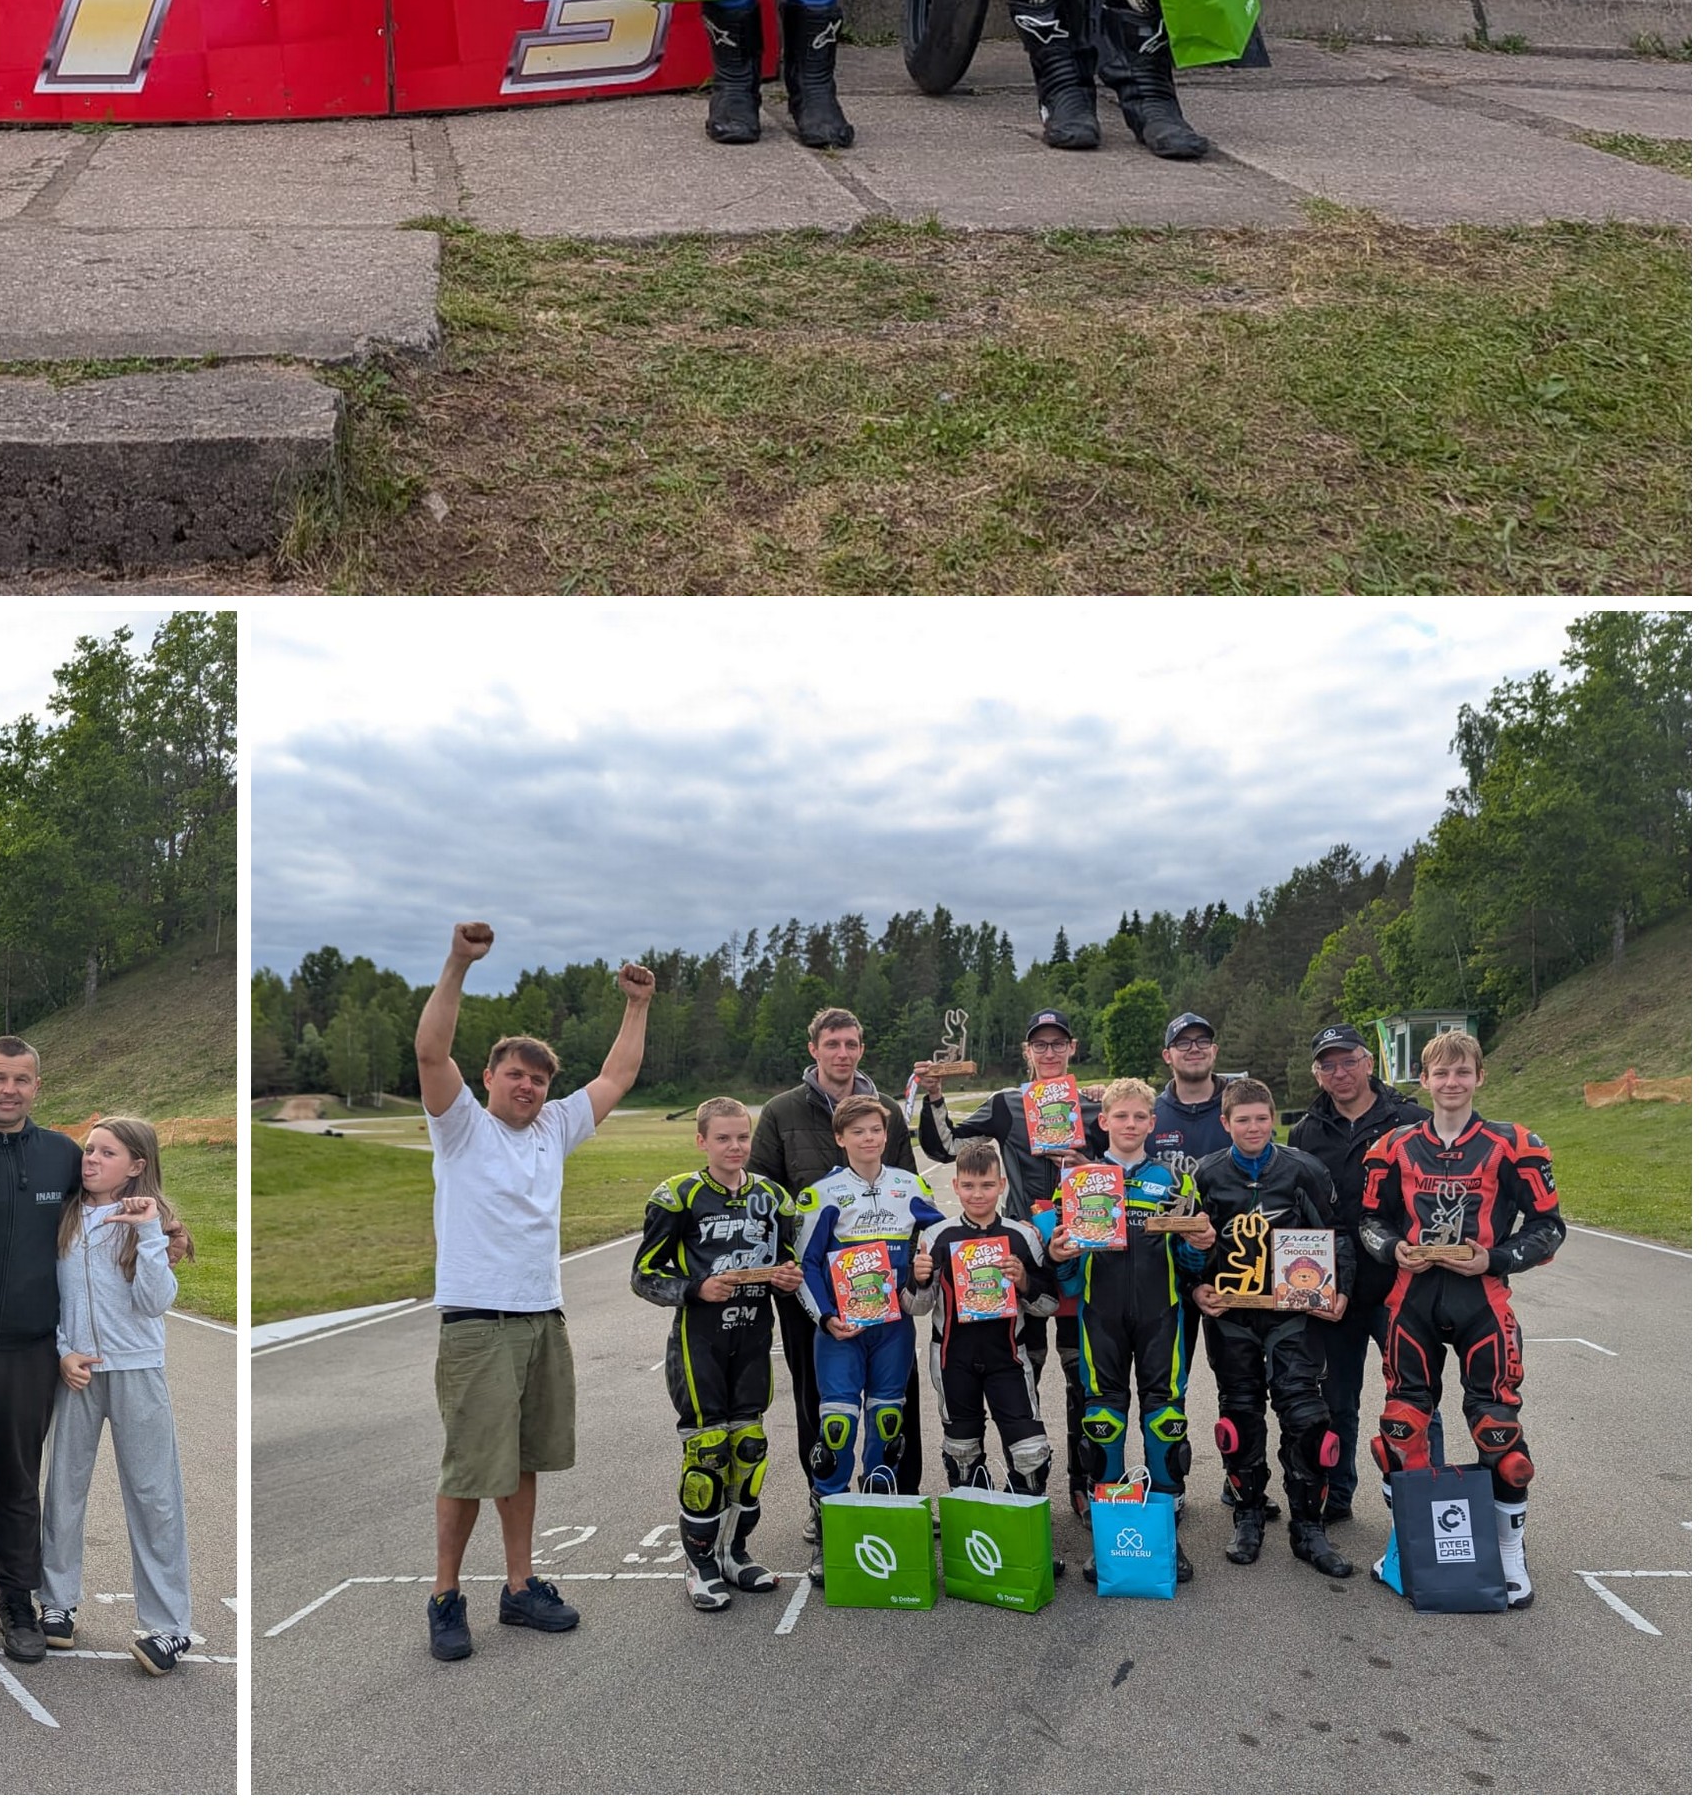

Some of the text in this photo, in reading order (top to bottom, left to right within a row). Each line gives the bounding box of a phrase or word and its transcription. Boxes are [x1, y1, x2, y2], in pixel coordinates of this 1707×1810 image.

[1036, 1090, 1071, 1106] LOOPS
[1075, 1182, 1116, 1196] LOOPS
[1277, 1232, 1328, 1250] graci
[1283, 1249, 1325, 1257] CHOCOLATE
[965, 1253, 1003, 1270] LOOPS
[846, 1260, 883, 1278] LOOPS
[1437, 1540, 1470, 1549] INTER
[1439, 1548, 1472, 1557] CARS
[896, 1595, 922, 1604] Dobele
